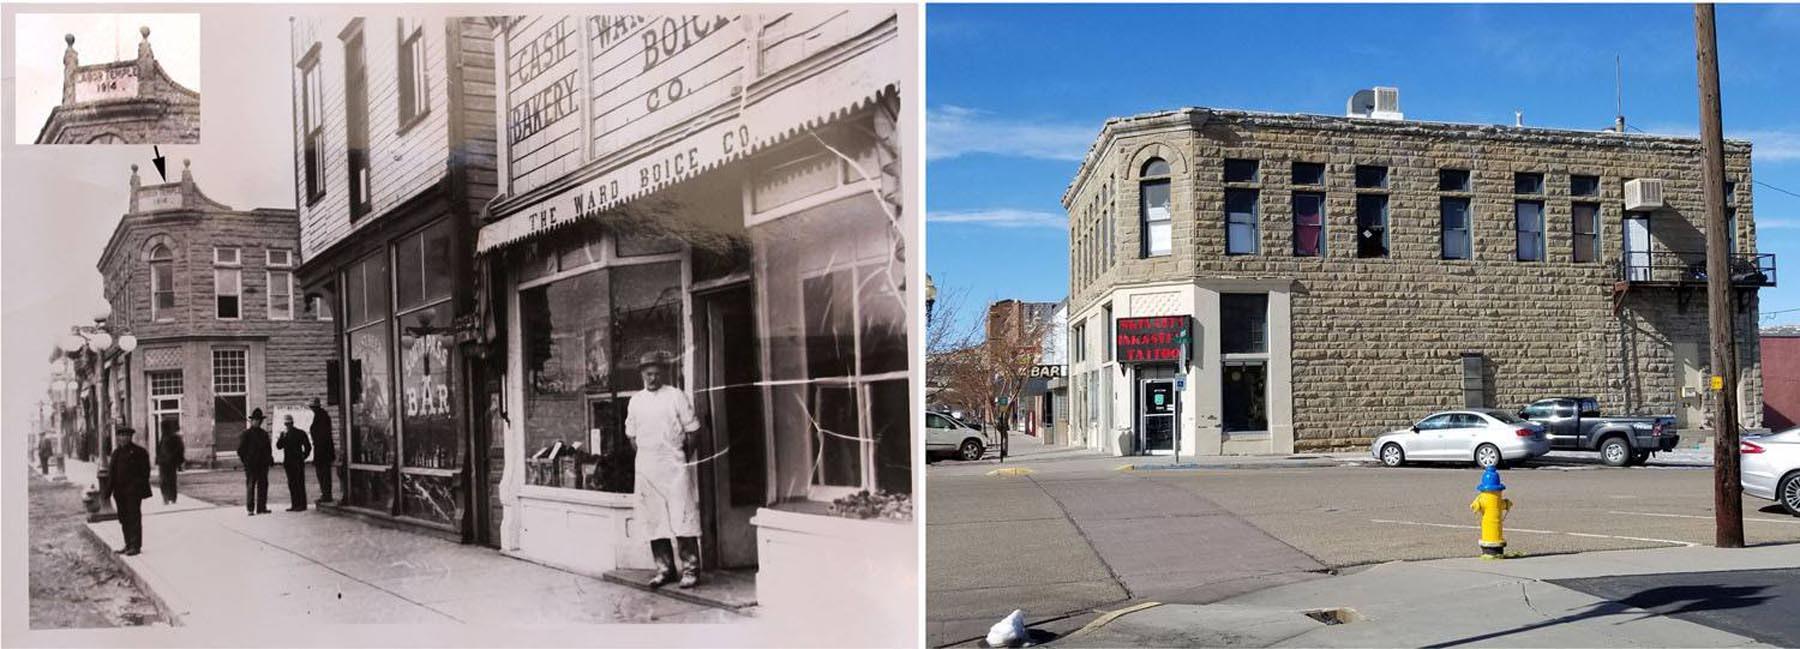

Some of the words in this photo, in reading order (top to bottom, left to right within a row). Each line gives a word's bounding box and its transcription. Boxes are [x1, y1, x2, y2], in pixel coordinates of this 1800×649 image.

[518, 19, 568, 84] CASH
[645, 77, 692, 113] CO.
[528, 206, 557, 231] THE
[574, 179, 620, 214] WARD
[639, 147, 699, 189] BOICE
[1031, 366, 1060, 379] BAR
